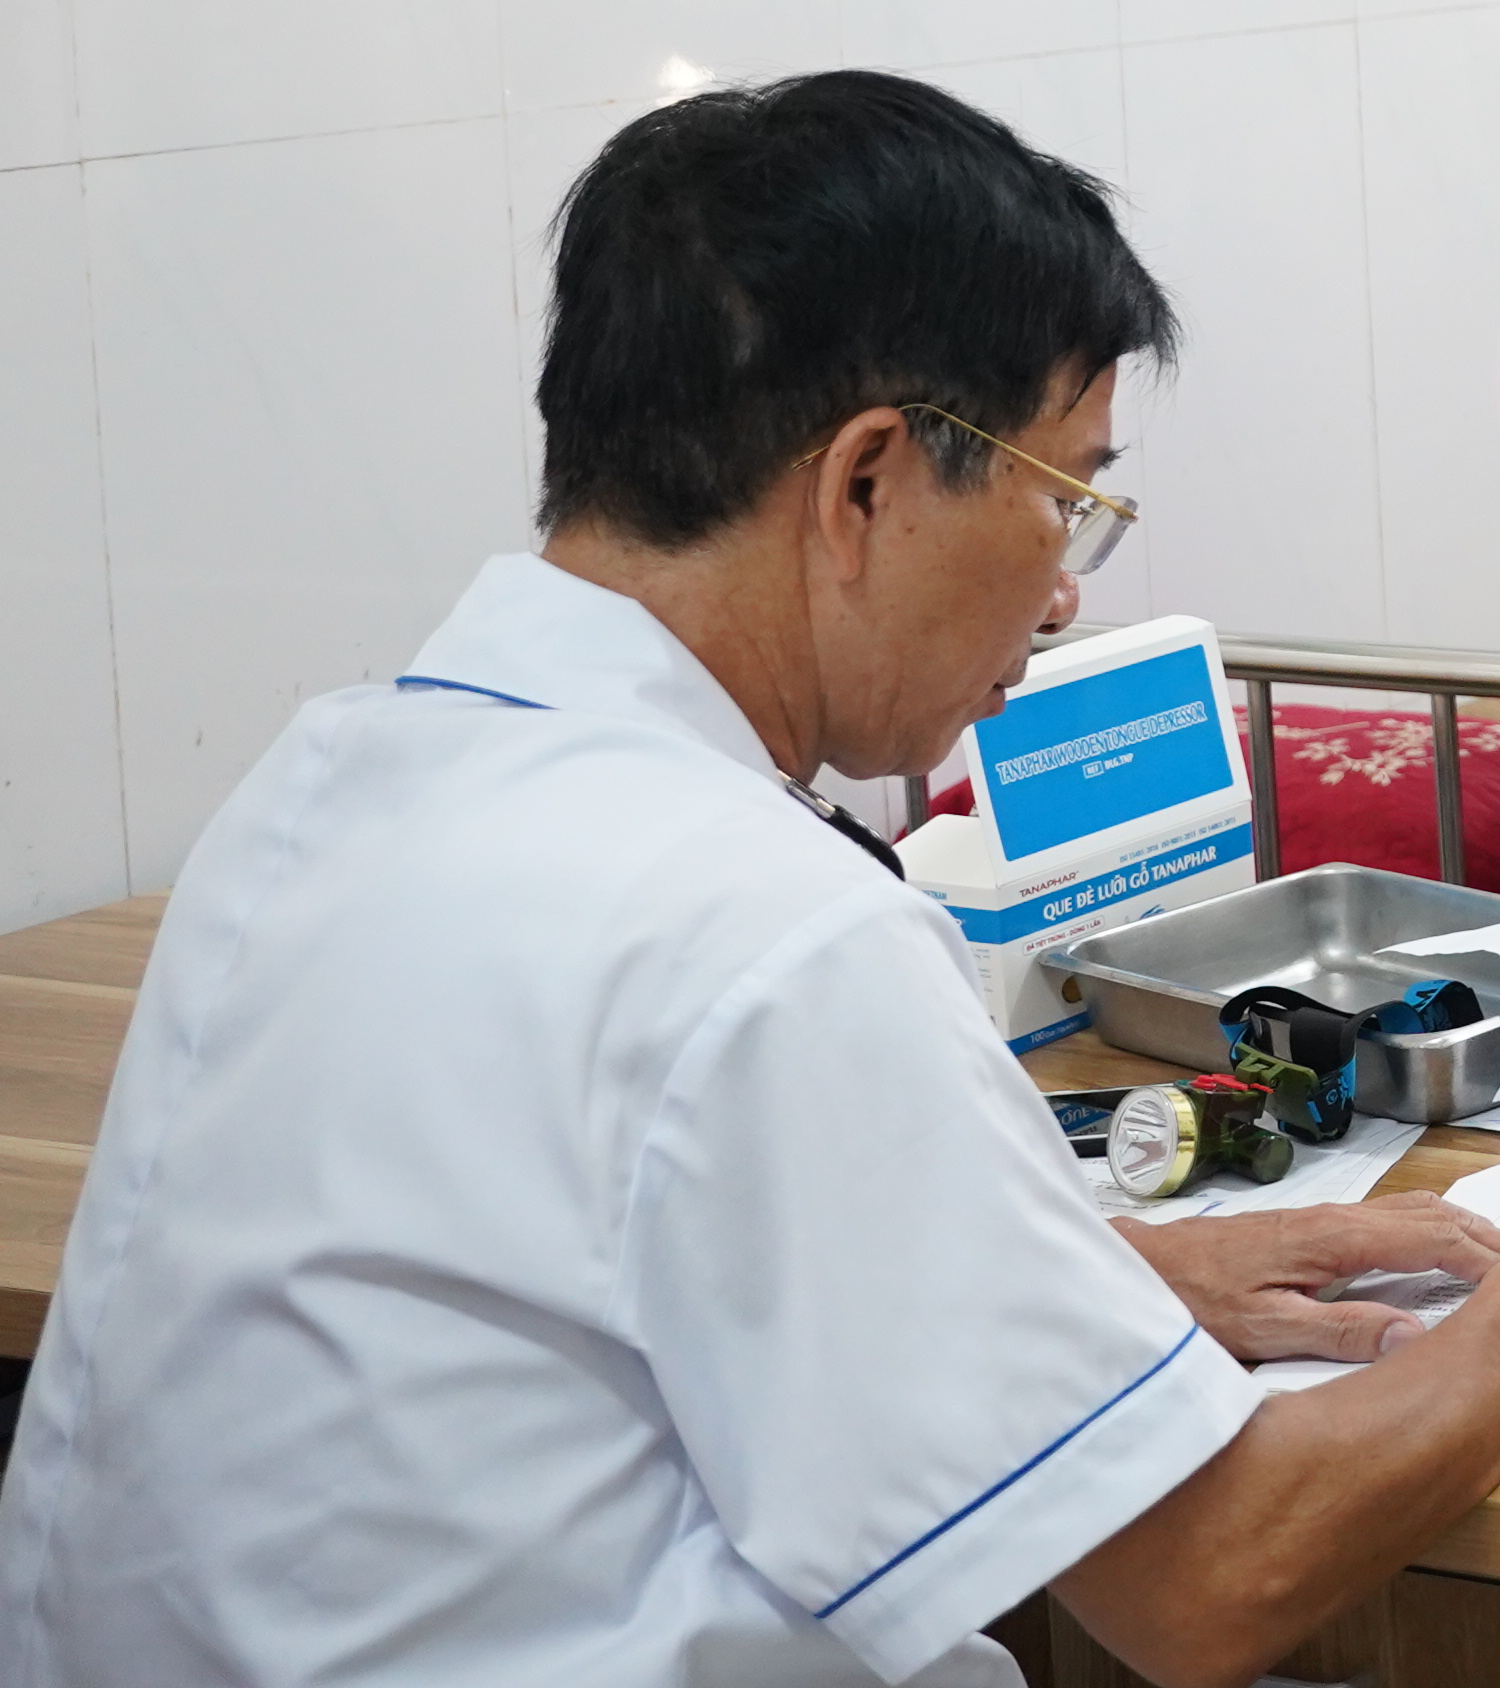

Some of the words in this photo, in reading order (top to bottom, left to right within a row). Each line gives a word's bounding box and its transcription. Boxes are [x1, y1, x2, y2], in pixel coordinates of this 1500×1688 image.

[996, 748, 1058, 785] TANAPHAR
[1055, 731, 1104, 765] WOODEN
[1104, 718, 1149, 750] TONGUE
[1149, 701, 1208, 738] DEPRESSOR
[1019, 872, 1077, 897] TANAPHAR
[1043, 896, 1073, 921] QUE
[1076, 885, 1096, 910] ĐÈ
[1097, 875, 1127, 902] LƯỠI
[1130, 861, 1150, 890] GỖ
[1151, 845, 1217, 882] TANAPHAR
